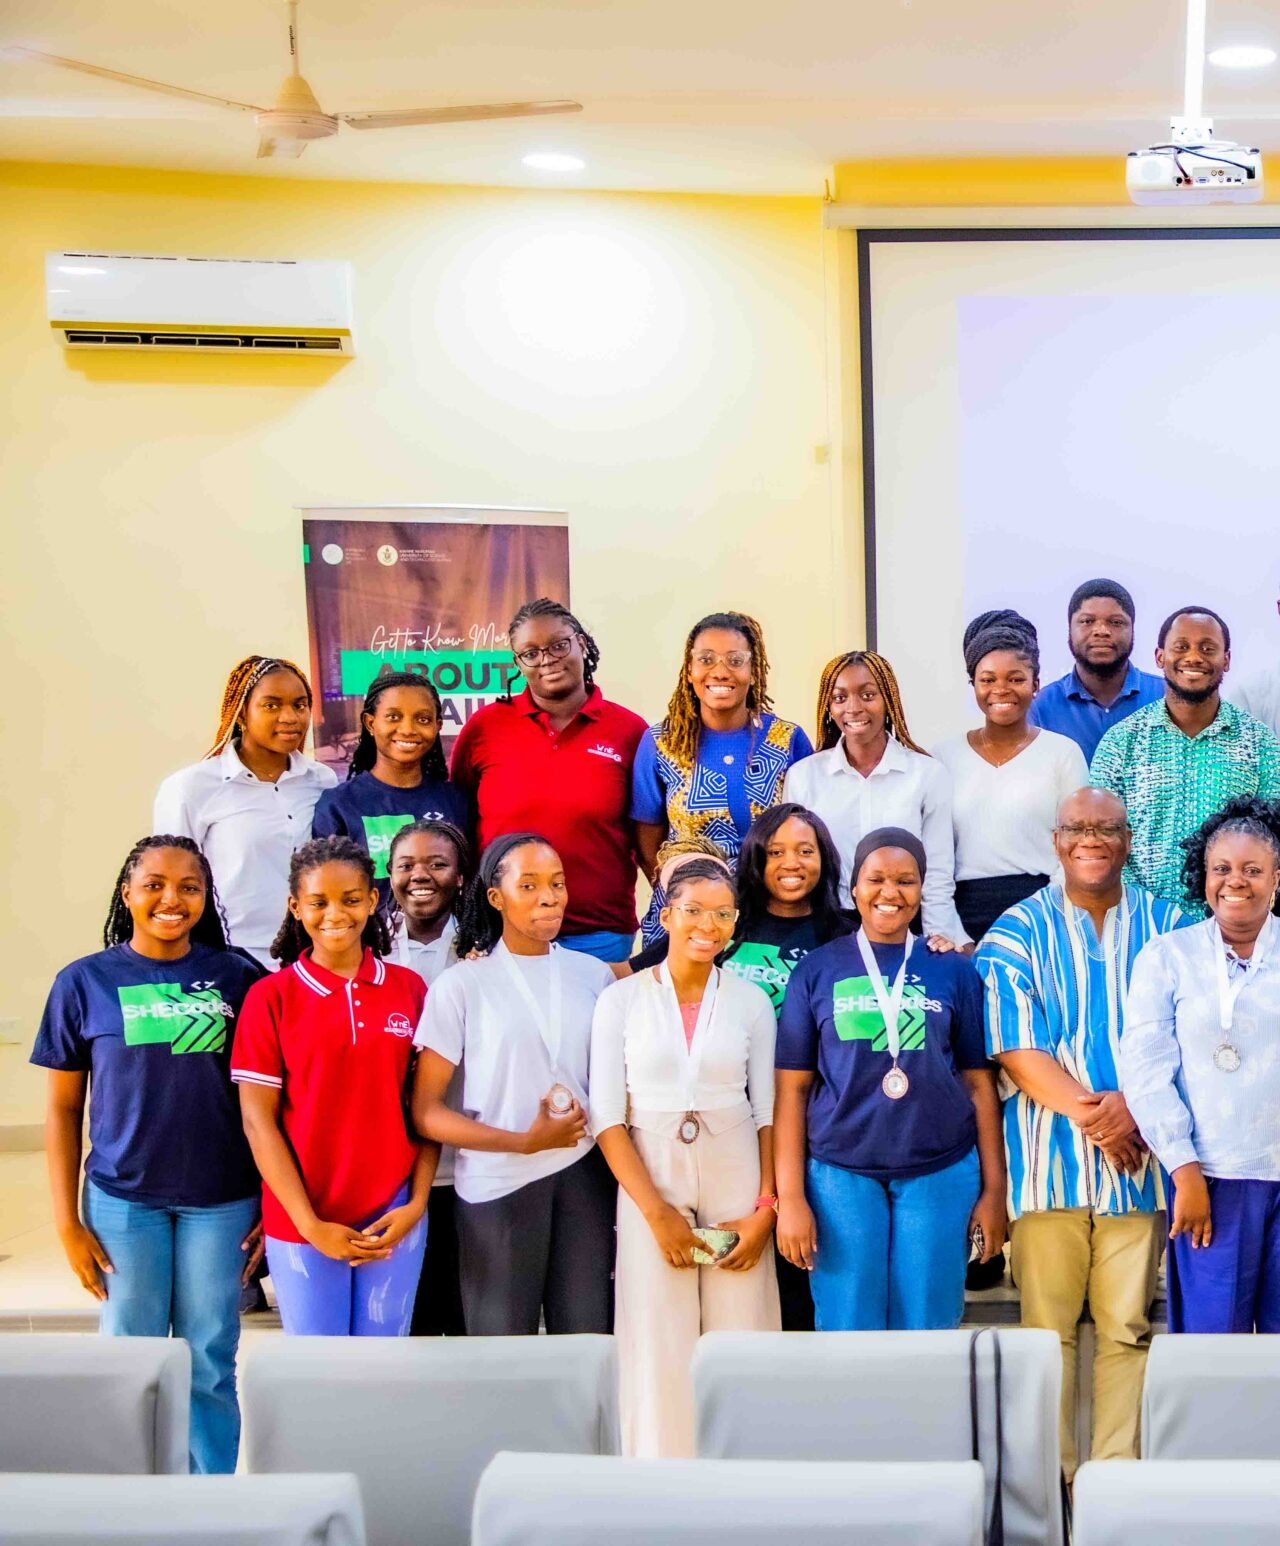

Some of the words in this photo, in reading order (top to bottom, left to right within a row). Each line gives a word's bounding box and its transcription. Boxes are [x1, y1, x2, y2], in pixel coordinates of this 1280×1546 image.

[371, 625, 400, 659] Get
[422, 622, 465, 656] Know
[469, 622, 510, 656] Mor
[122, 999, 235, 1018] SHECodes
